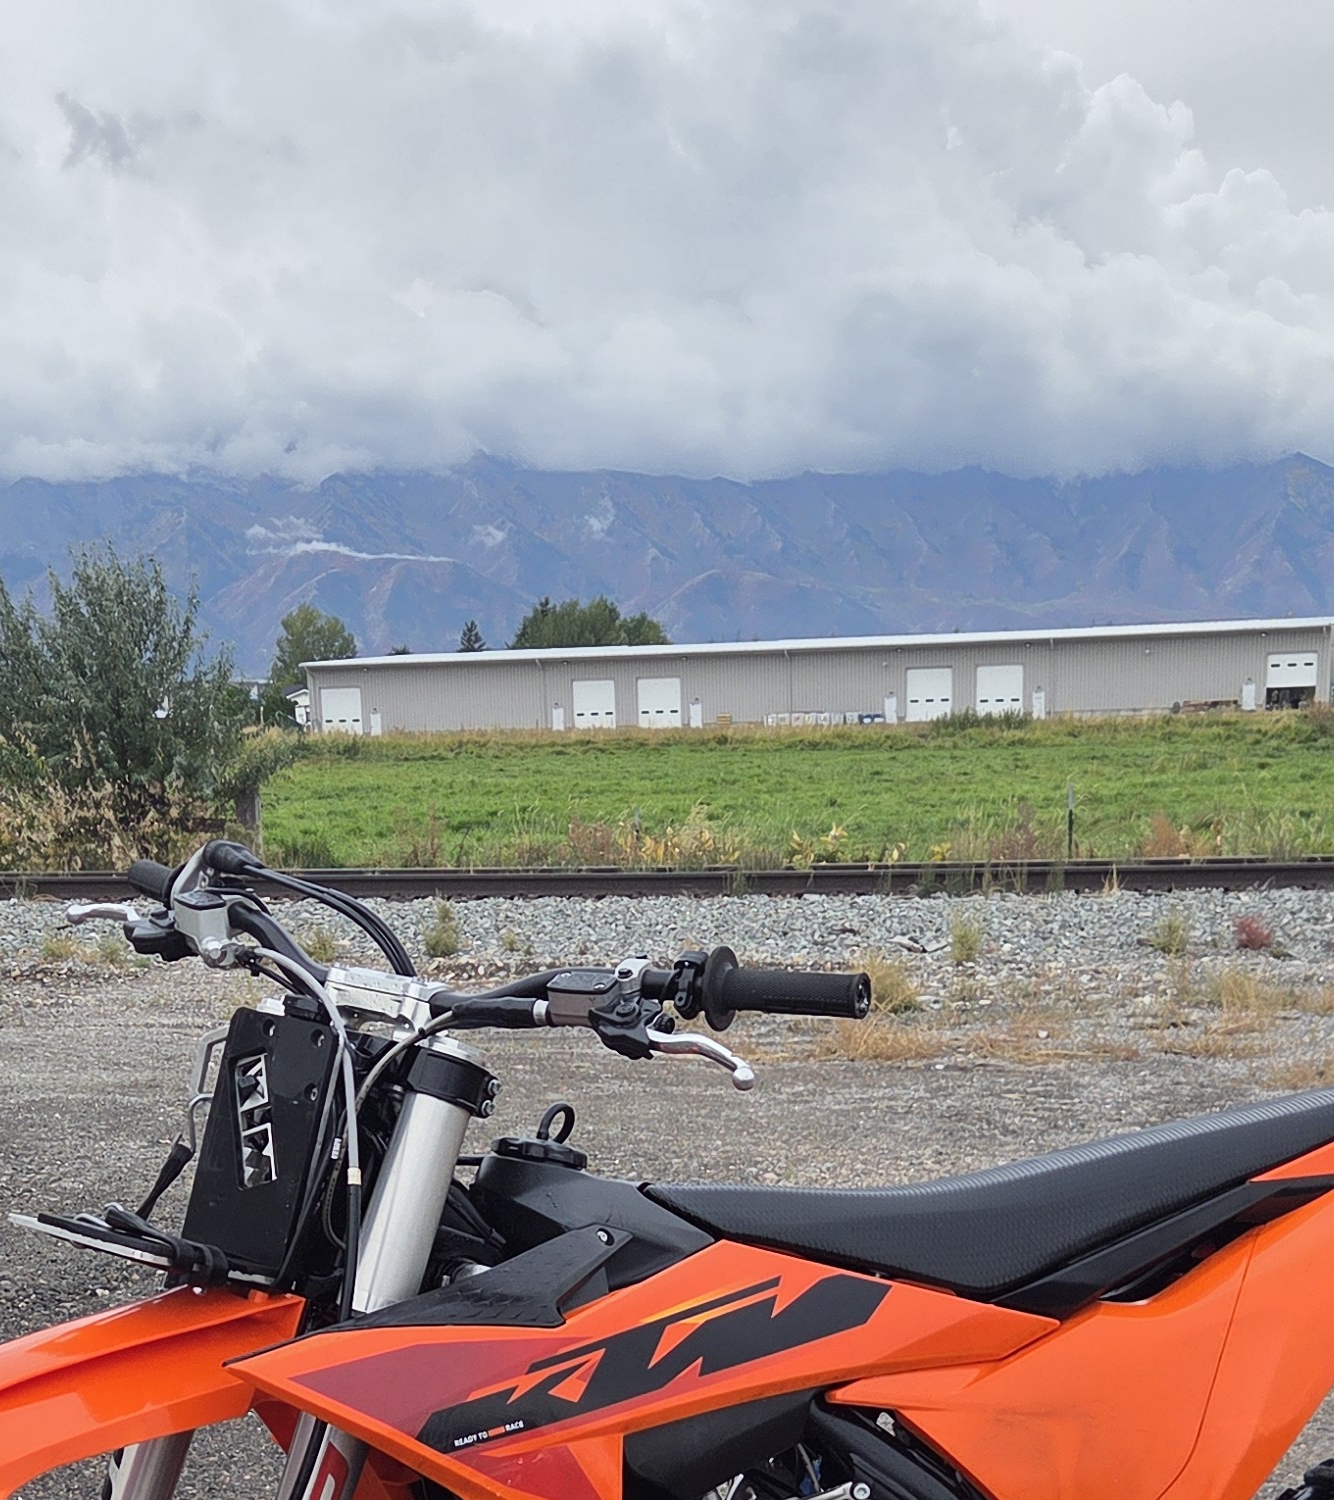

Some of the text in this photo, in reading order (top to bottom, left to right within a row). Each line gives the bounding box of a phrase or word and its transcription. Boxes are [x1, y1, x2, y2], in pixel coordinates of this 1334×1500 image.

[416, 1274, 893, 1453] KTM
[453, 1434, 478, 1447] READY
[478, 1430, 488, 1440] TO
